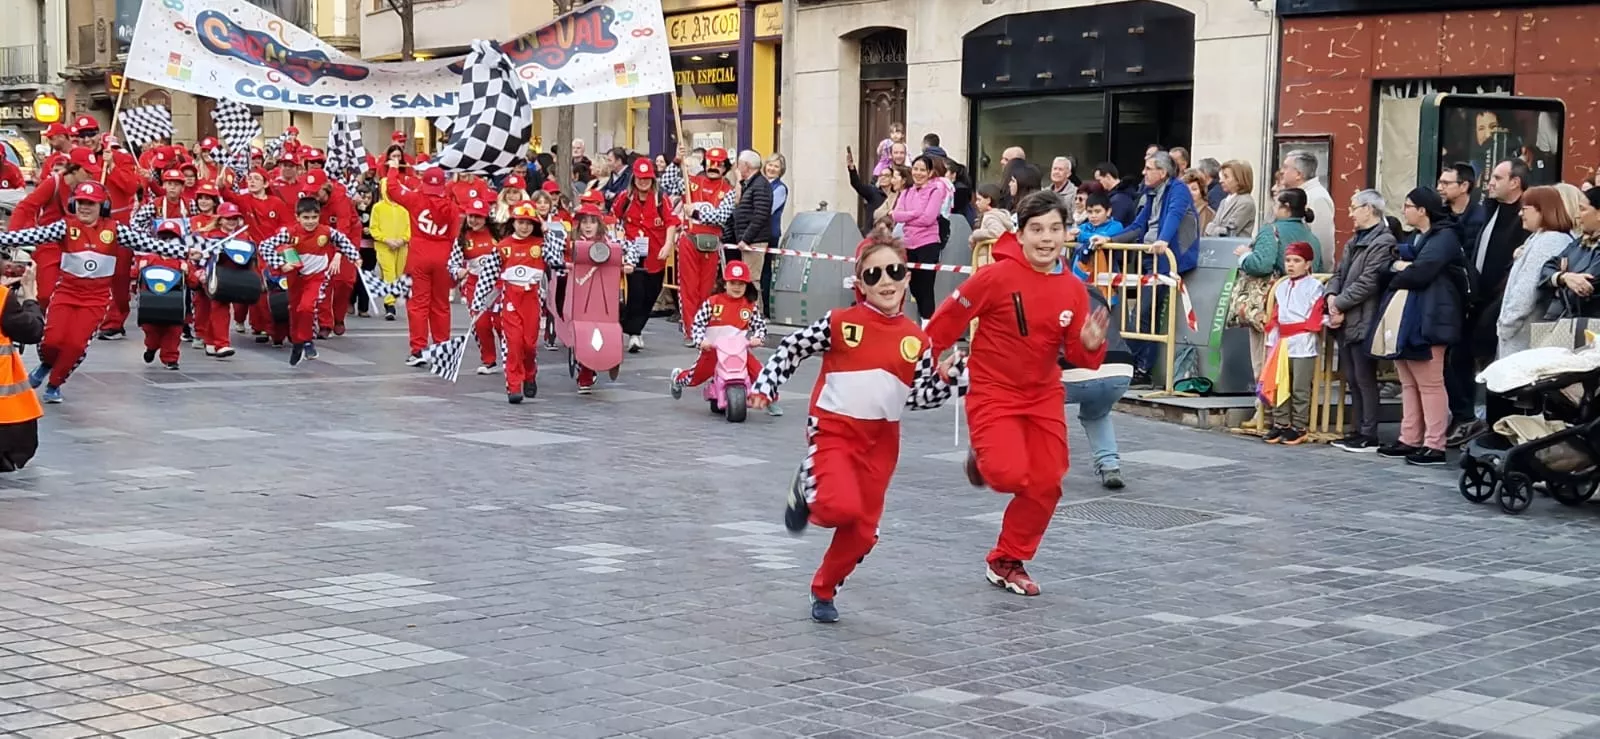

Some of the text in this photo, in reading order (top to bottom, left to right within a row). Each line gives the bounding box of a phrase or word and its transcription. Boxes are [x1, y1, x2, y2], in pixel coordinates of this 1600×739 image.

[697, 66, 736, 84] ESPECIAL
[234, 78, 374, 109] COLEGIO
[527, 77, 575, 101] NA
[1212, 281, 1233, 332] VIDRIO
[844, 325, 859, 343] 1
